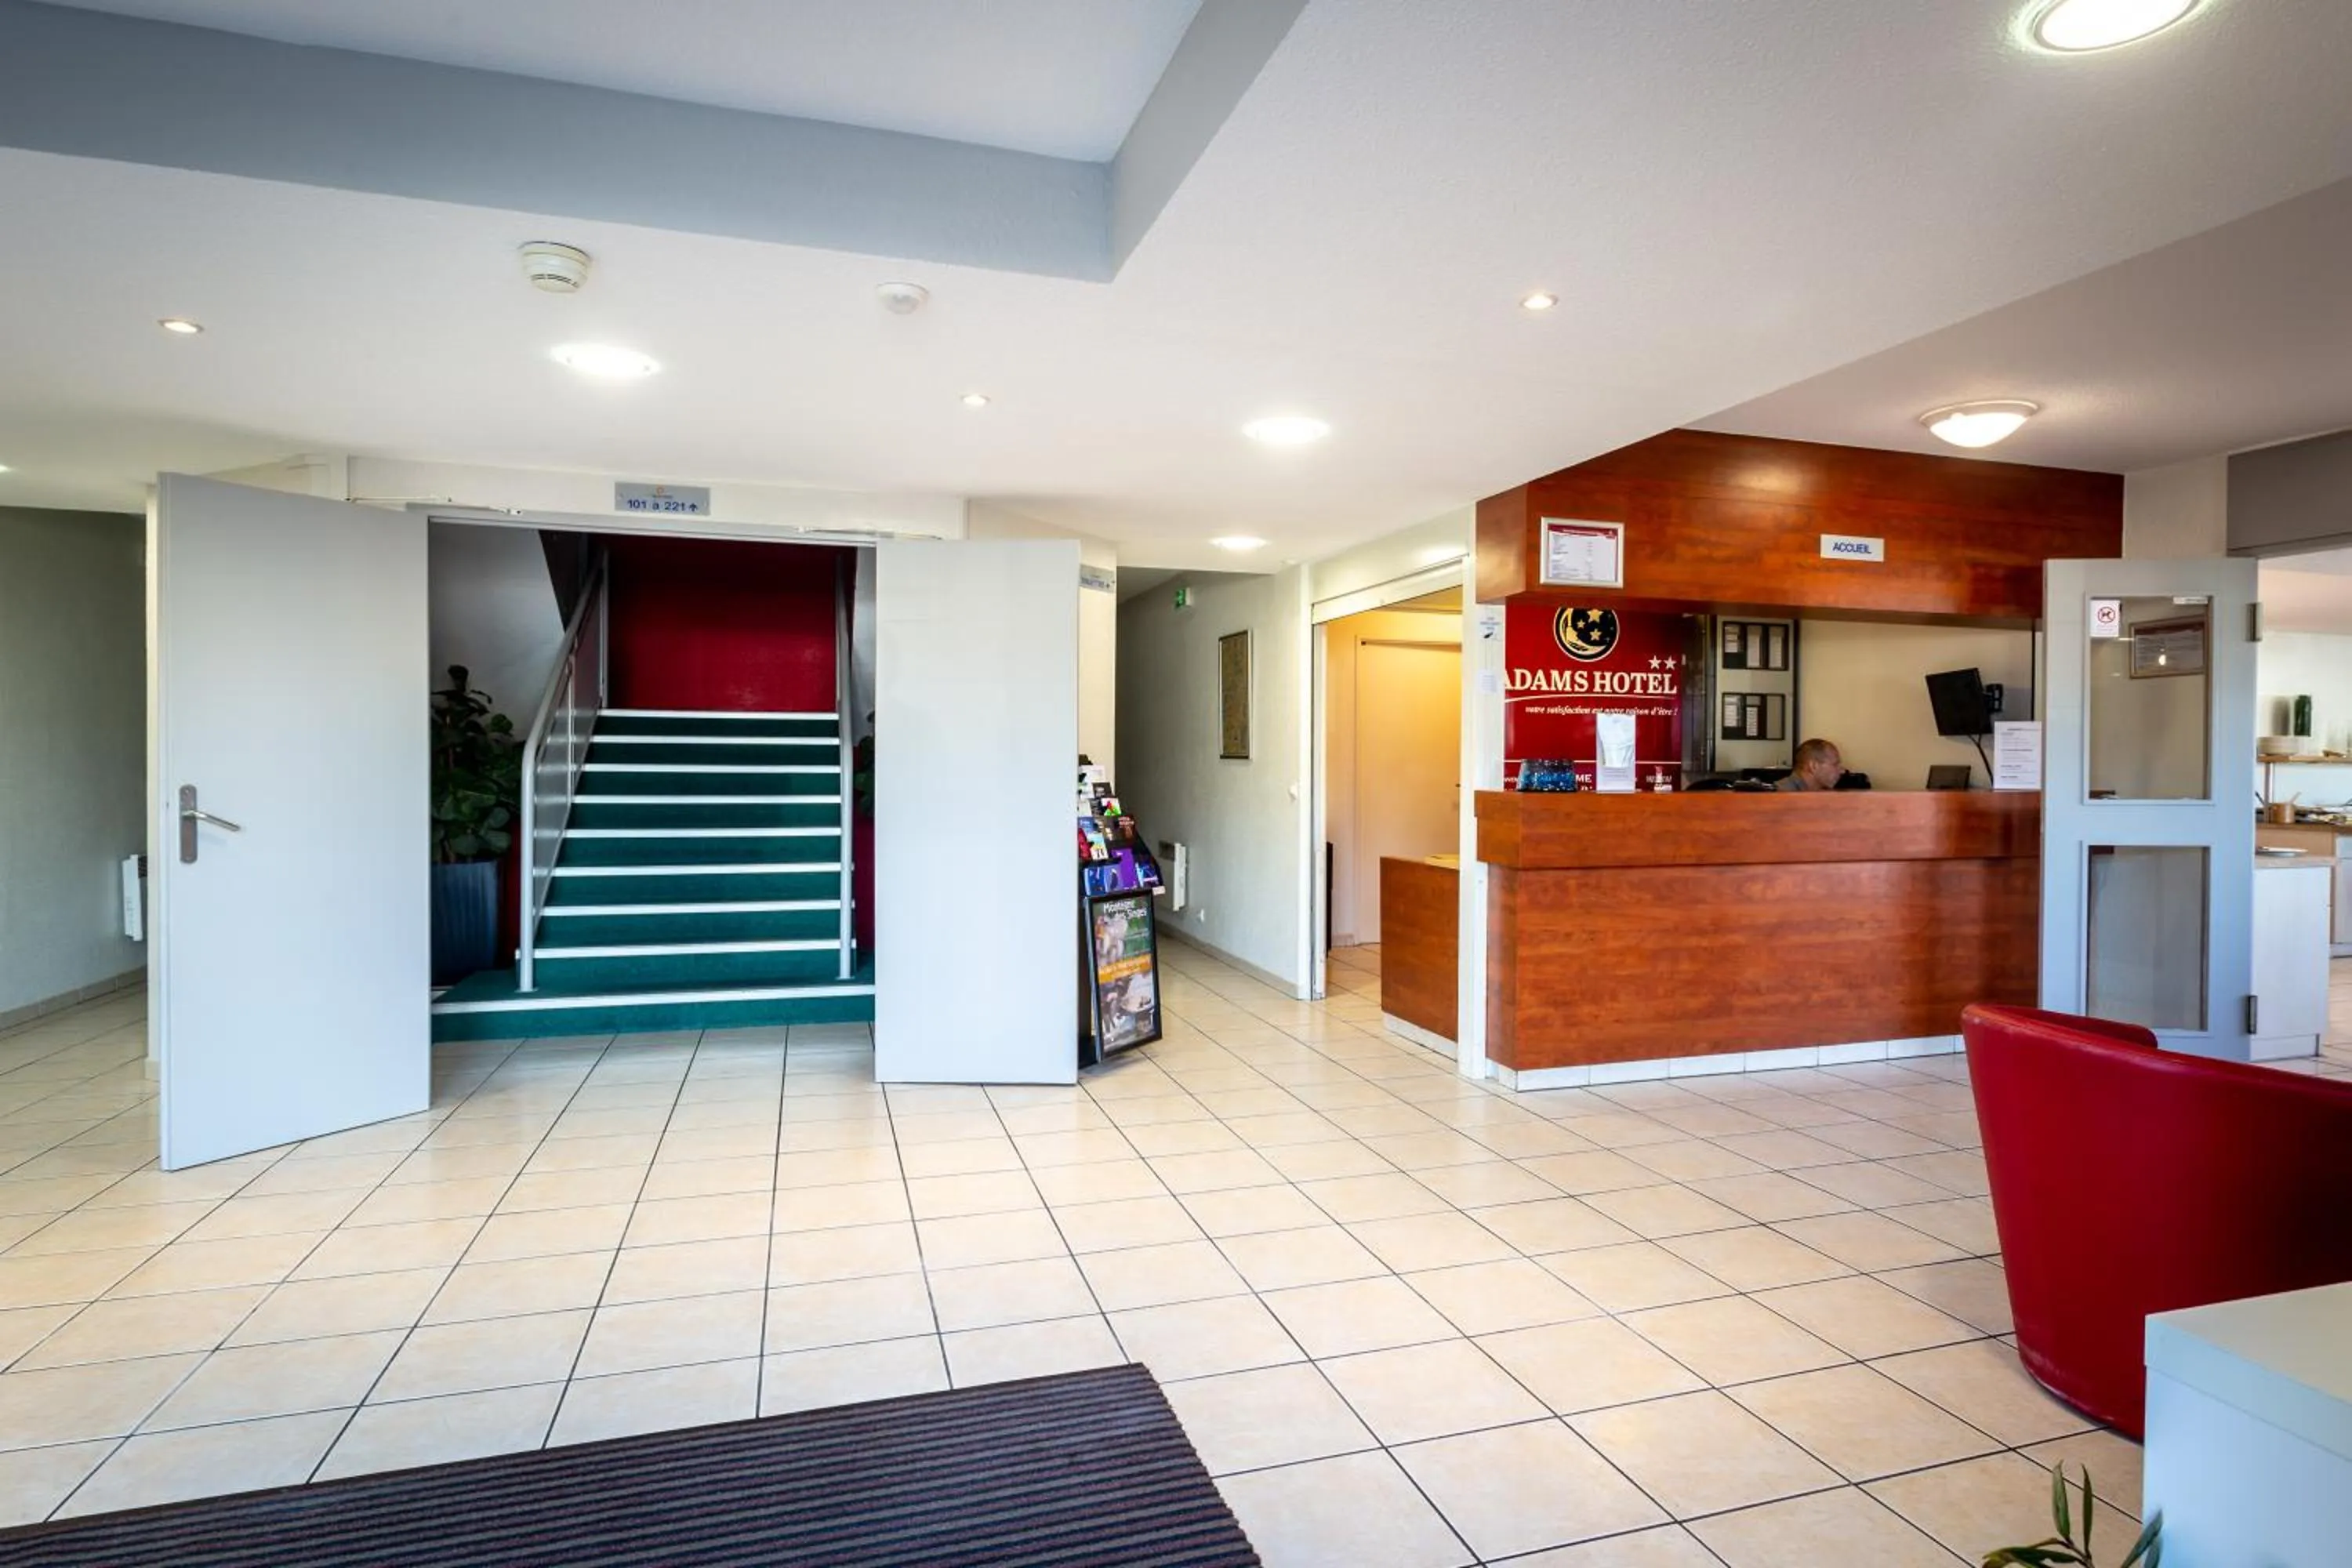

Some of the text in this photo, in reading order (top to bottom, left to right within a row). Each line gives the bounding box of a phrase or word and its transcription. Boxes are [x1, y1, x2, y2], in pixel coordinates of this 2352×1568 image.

[628, 499, 647, 509] 101
[664, 501, 685, 511] 221
[1832, 542, 1872, 554] ACCUEIL
[1593, 672, 1677, 694] HOTEL
[1547, 705, 1590, 715] satisfaction
